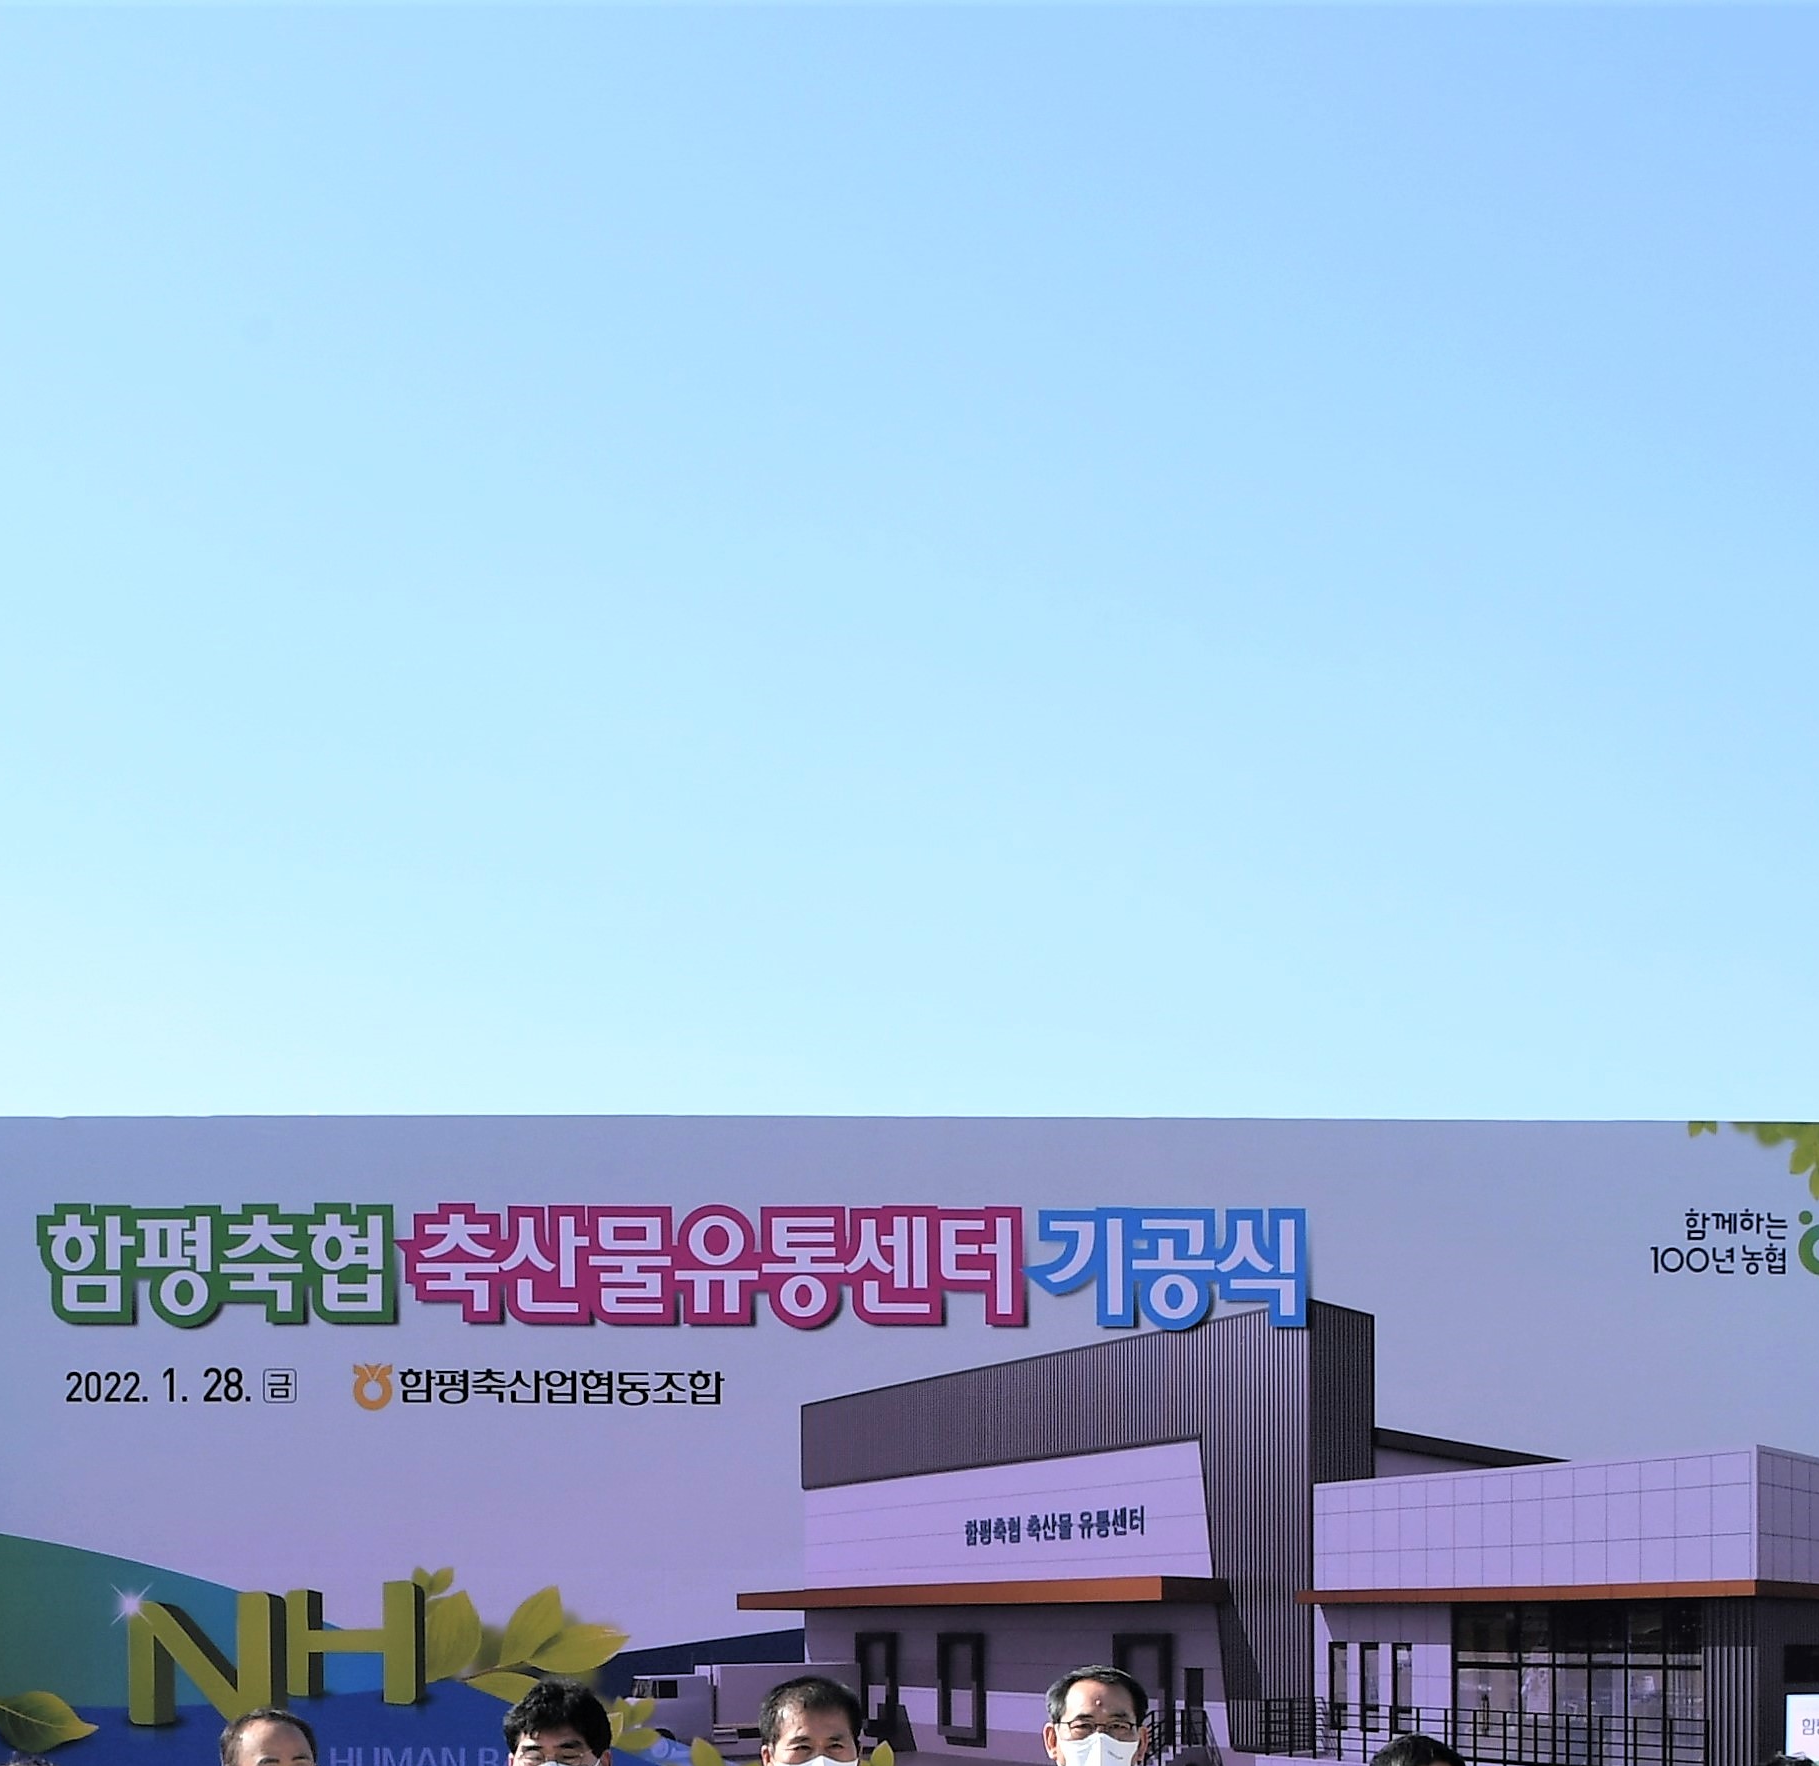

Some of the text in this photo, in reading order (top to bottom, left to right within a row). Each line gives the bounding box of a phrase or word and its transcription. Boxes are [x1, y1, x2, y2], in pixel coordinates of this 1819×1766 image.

[1685, 1208, 1788, 1241] 함께하는
[47, 1213, 1296, 1320] 함평축협 축산물유통센터 기공식
[1650, 1243, 1787, 1275] 100년 농협
[66, 1371, 148, 1403] 2022.
[162, 1367, 187, 1403] 1.
[202, 1367, 251, 1403] 28.
[399, 1368, 725, 1406] 함평축산업협동조합
[965, 1505, 1145, 1546] 함평축협 축산물 유통센터
[129, 1580, 427, 1722] NH
